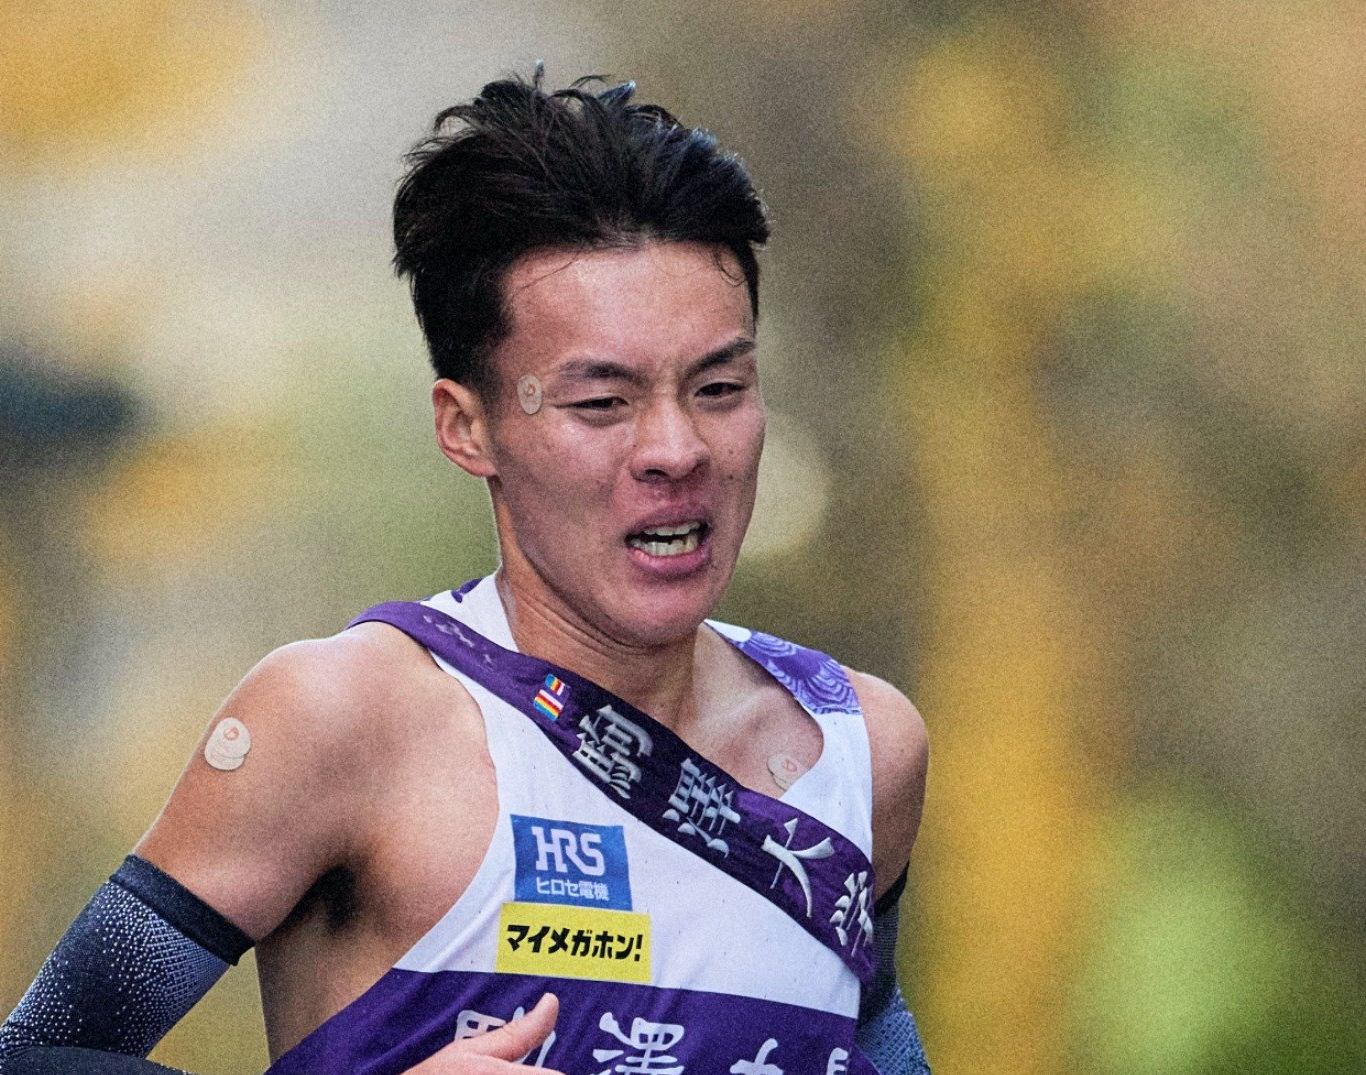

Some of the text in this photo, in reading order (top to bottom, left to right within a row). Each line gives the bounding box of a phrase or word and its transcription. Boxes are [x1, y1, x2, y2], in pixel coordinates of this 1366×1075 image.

[531, 826, 605, 876] HRS
[536, 876, 610, 901] ヒロセ電機
[507, 924, 644, 962] マイメガホン!
